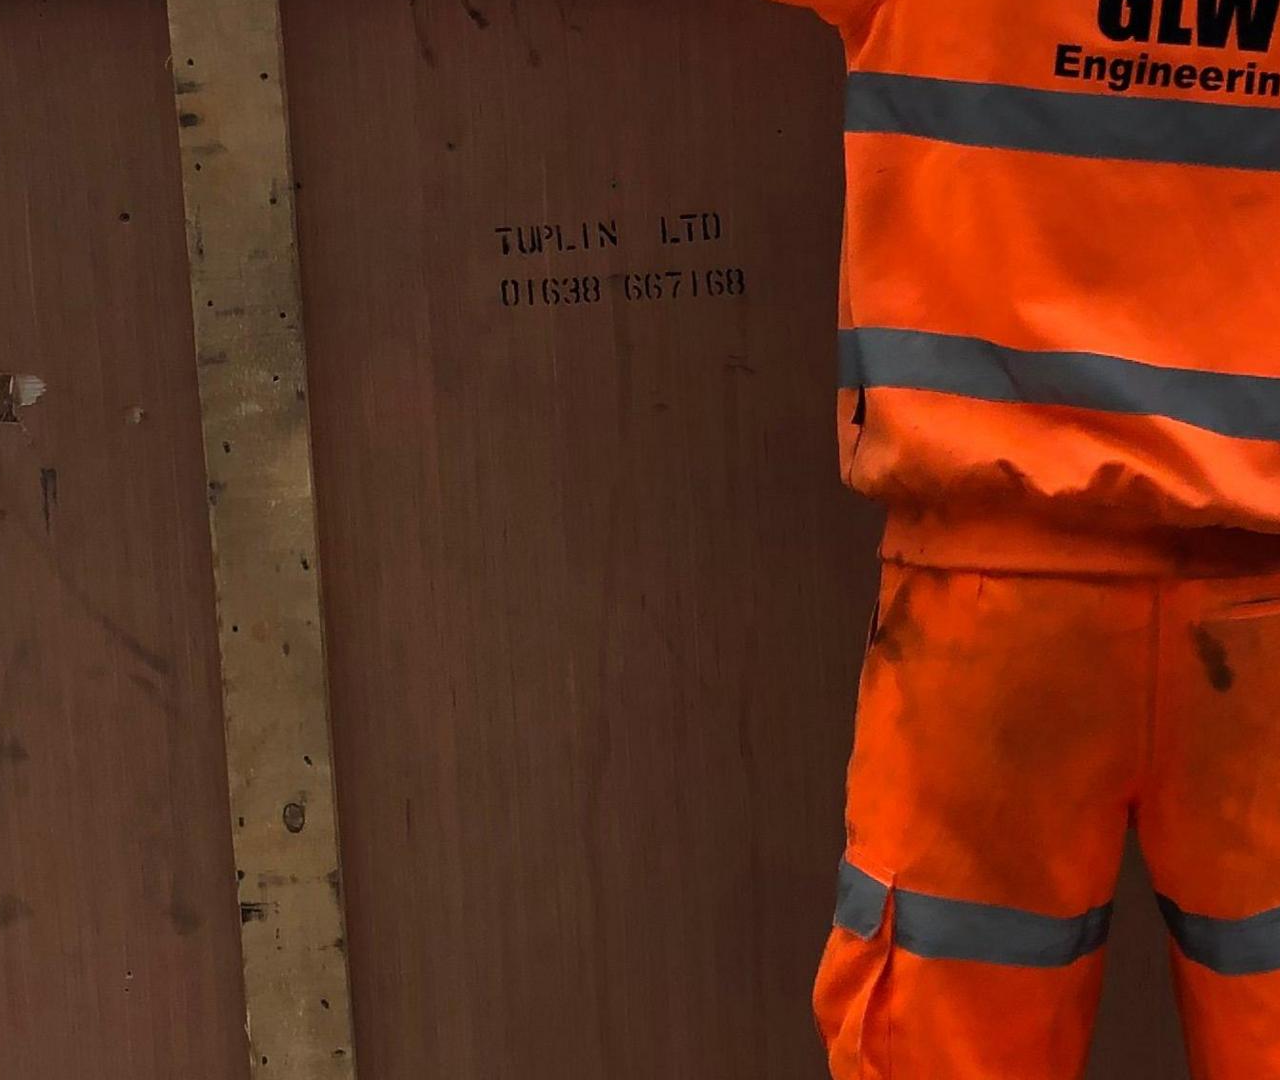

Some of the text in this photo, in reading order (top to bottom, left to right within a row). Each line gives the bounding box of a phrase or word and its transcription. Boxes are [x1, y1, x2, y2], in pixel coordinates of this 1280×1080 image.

[494, 212, 721, 256] TUPLIN LTD
[500, 268, 746, 307] 01638 667168
